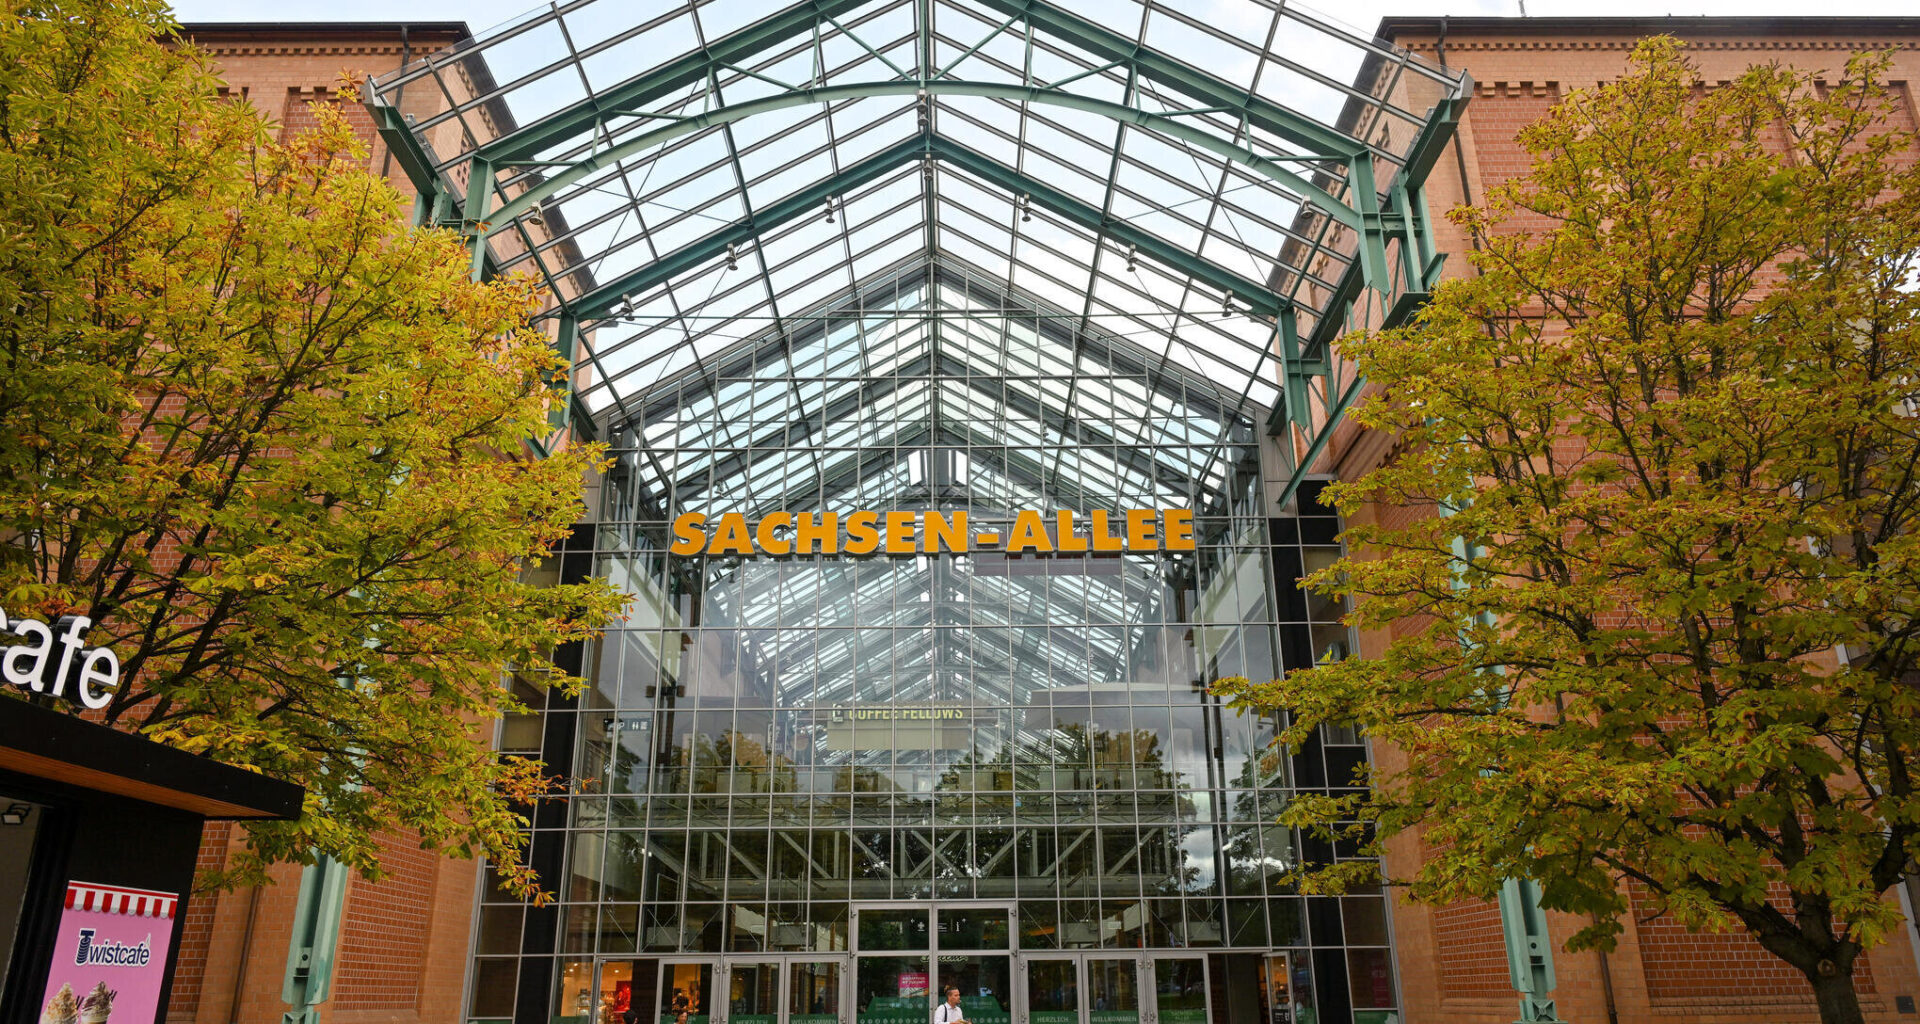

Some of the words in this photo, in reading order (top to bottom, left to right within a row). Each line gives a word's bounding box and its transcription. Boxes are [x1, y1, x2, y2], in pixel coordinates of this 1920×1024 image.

[669, 509, 1195, 556] SACHSEN-ALLEE
[0, 606, 119, 709] afe
[849, 705, 899, 720] COFFEE
[902, 705, 963, 720] FELLOWS
